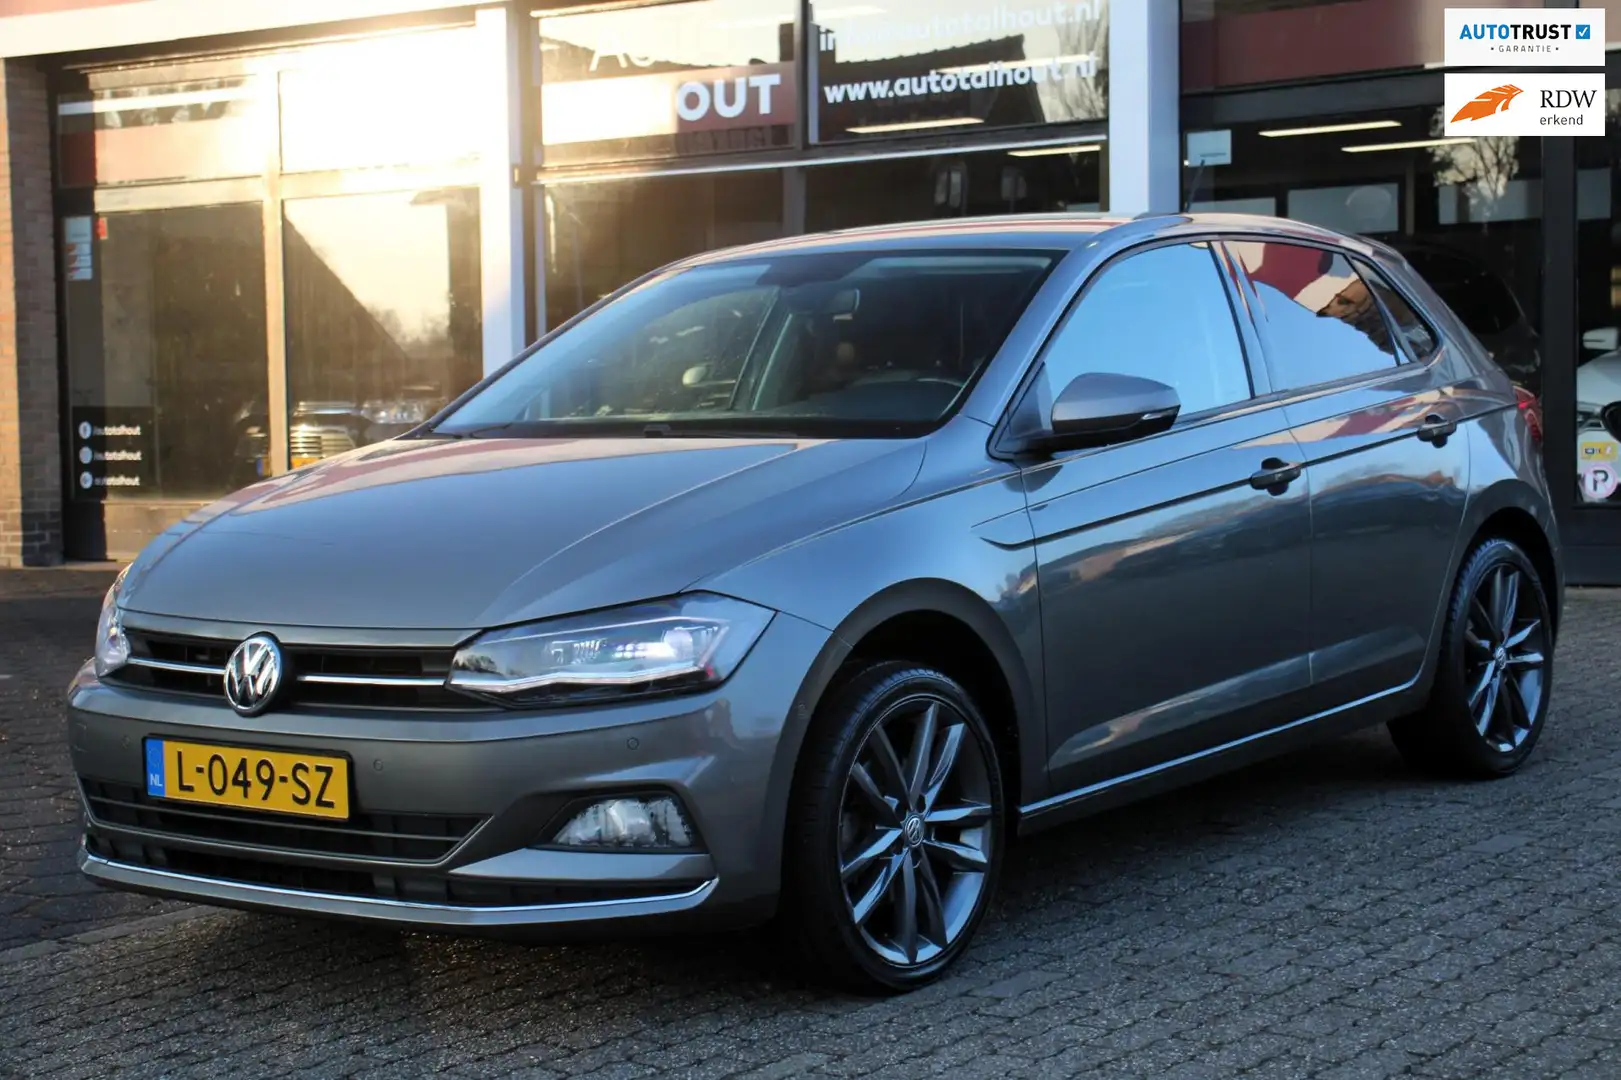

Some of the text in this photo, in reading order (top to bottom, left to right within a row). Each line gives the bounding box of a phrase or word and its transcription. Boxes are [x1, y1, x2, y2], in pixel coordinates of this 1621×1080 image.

[823, 51, 1098, 104] www.autotalhout.nl
[150, 750, 335, 809] NL L-049-SZ
